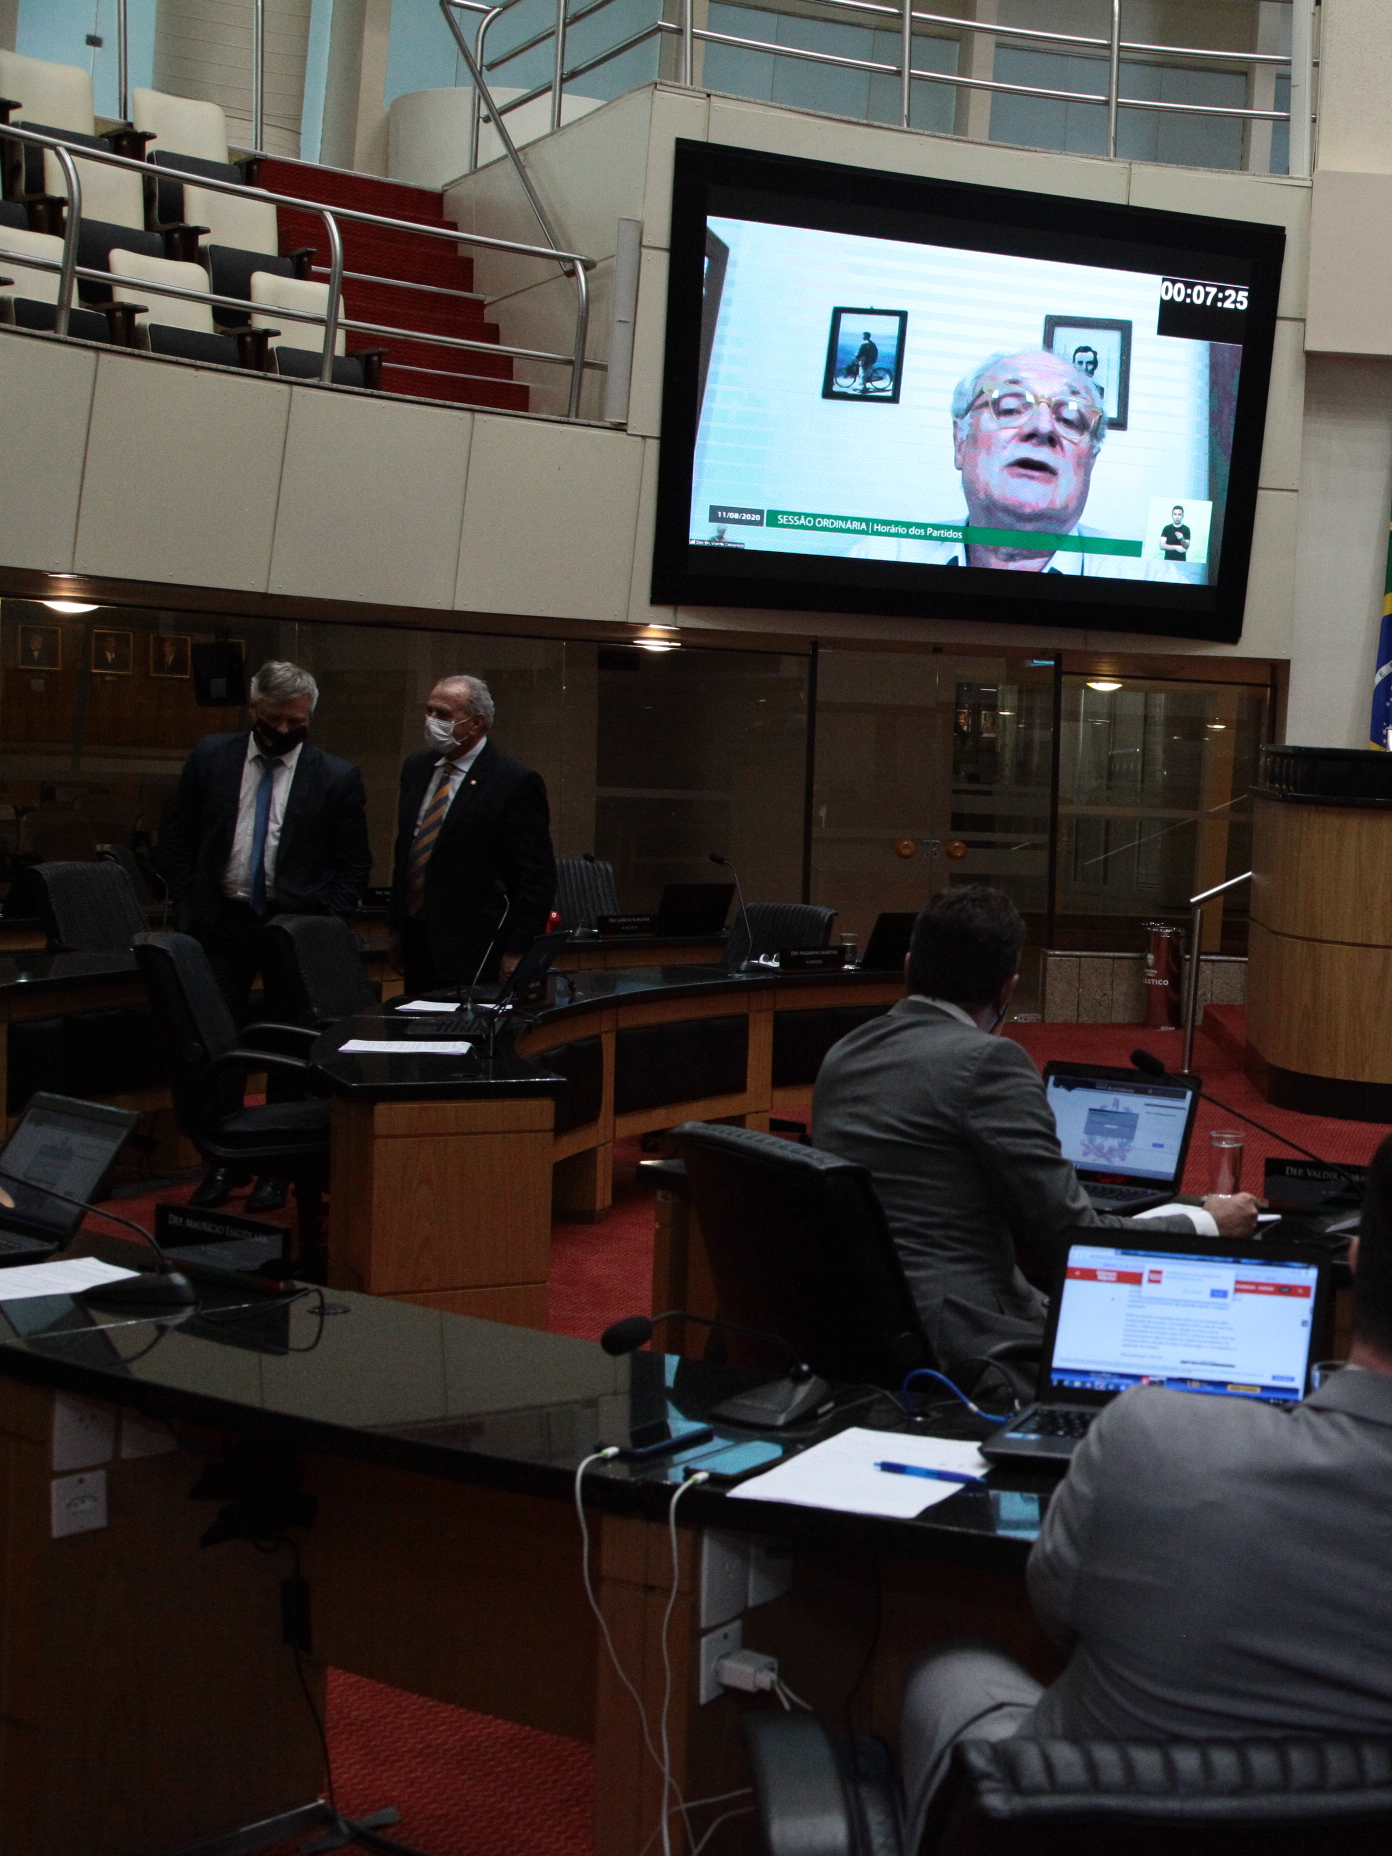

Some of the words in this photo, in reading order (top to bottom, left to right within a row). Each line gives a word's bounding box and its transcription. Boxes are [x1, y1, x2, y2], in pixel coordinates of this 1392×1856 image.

[1161, 281, 1249, 310] 00:07:25
[717, 511, 761, 521] 11/08/2020
[777, 514, 814, 526] SESSÃO
[815, 517, 867, 531] ORDINÁRIA
[873, 523, 907, 534] Horário
[908, 526, 925, 536] dos
[926, 528, 963, 539] Partidos
[1306, 1167, 1339, 1180] VALDIR
